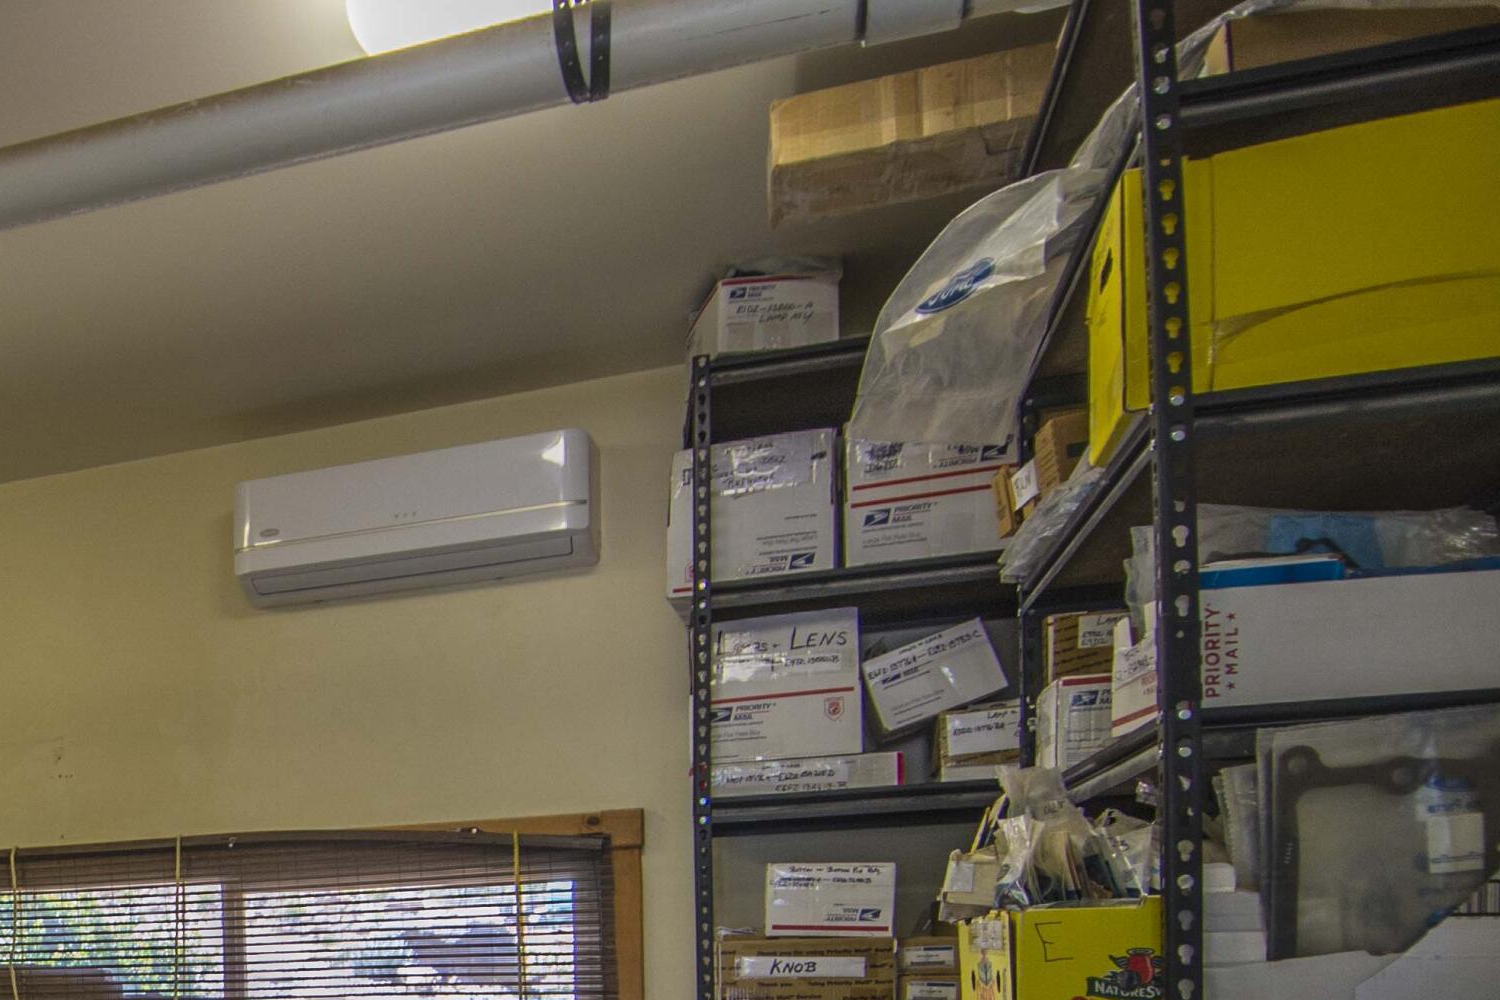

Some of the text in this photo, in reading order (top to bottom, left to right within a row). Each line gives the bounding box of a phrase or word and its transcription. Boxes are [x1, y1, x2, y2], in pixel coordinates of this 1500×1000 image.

[894, 502, 933, 513] PRIORITY
[892, 514, 912, 522] MAIL
[789, 626, 847, 650] LENS
[1205, 604, 1221, 698] PRIORITY
[1226, 628, 1239, 675] MAIL
[735, 703, 771, 712] PRIORITY
[770, 958, 817, 976] KNOB
